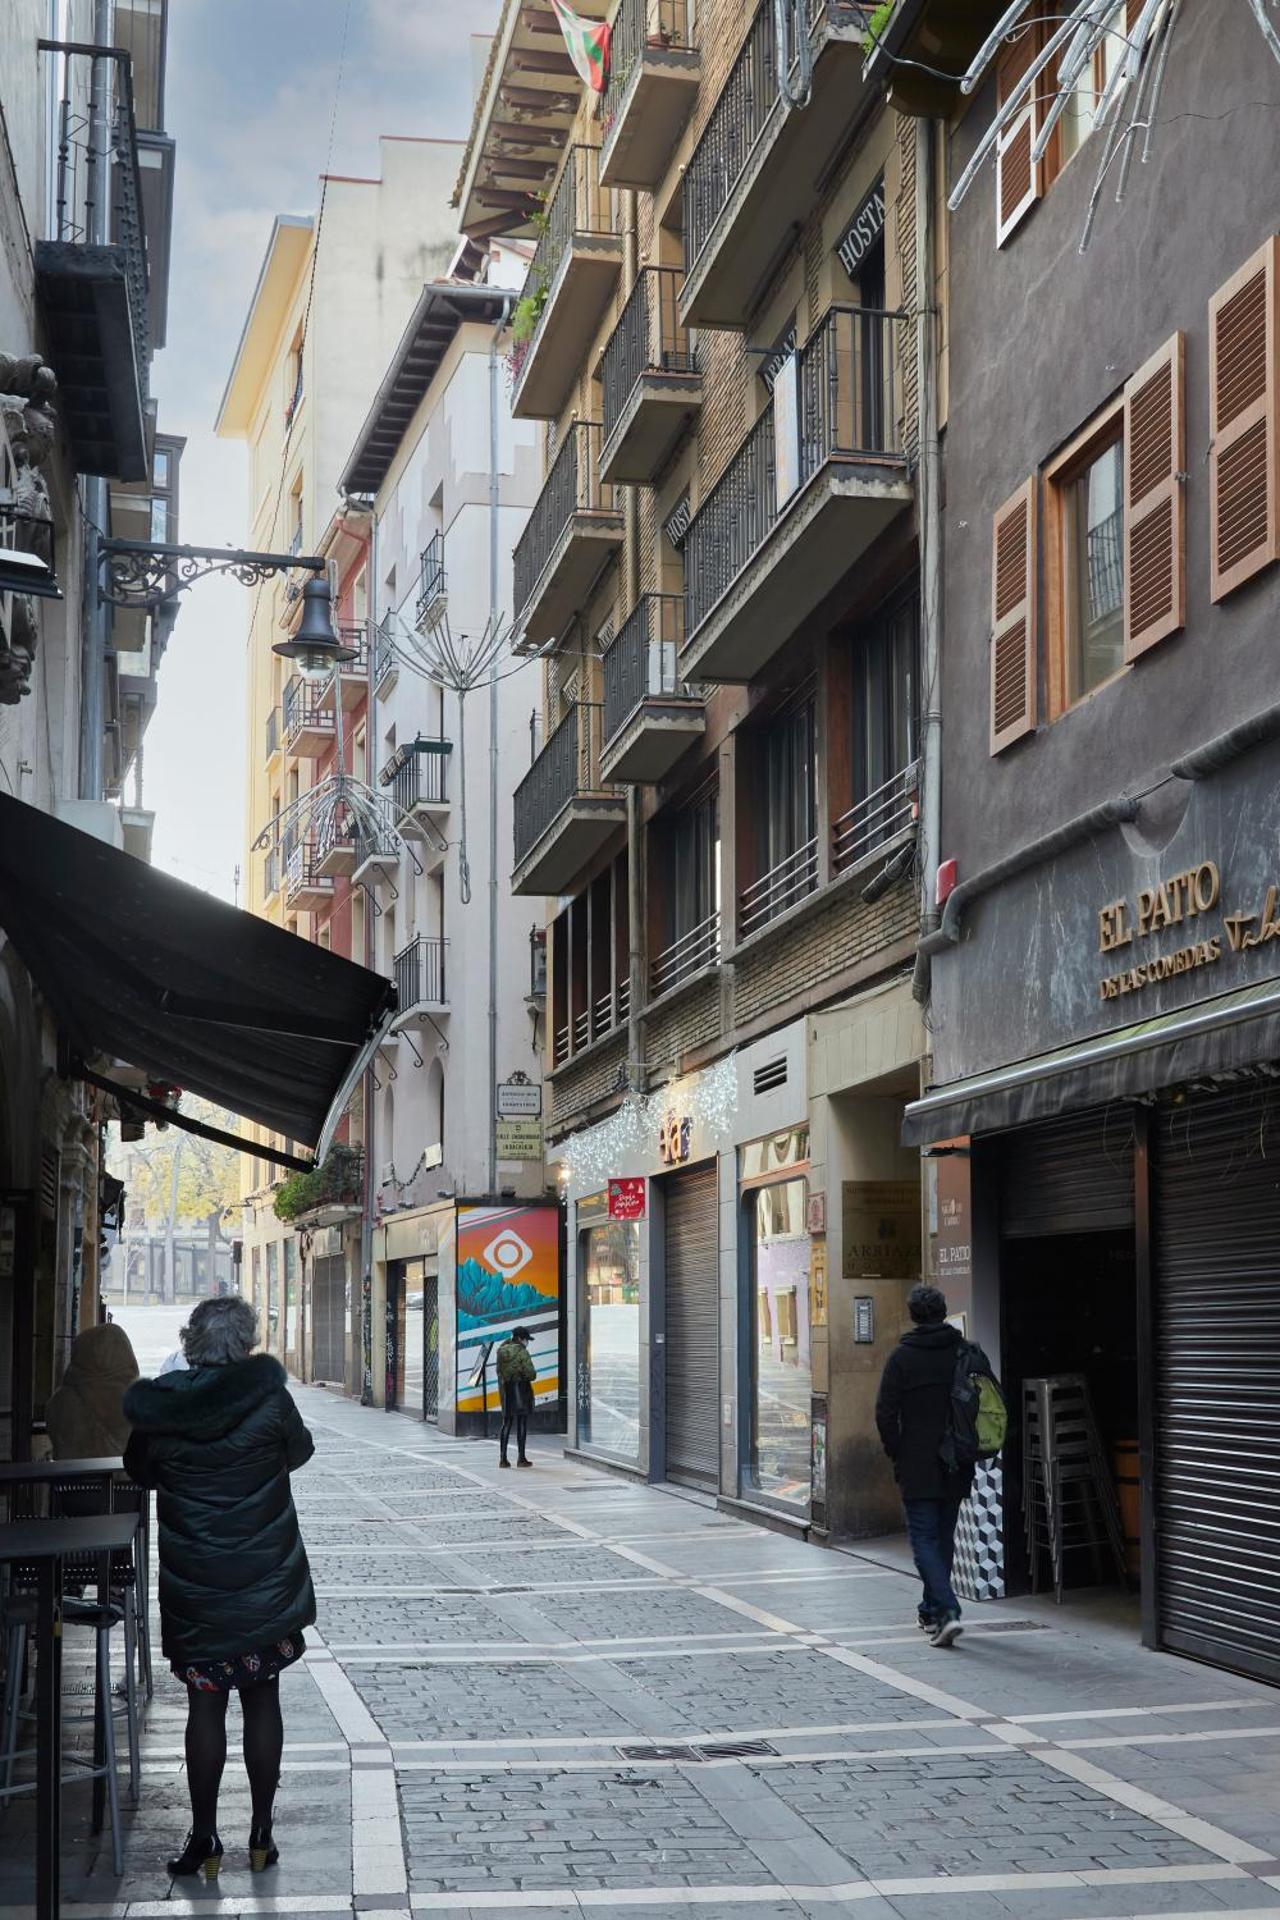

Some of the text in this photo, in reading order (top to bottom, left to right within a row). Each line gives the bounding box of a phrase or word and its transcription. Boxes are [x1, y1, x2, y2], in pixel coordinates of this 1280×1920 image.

[1099, 861, 1220, 952] EL PATIO
[1120, 968, 1146, 991] LAS
[1149, 939, 1221, 982] COMEDIAS
